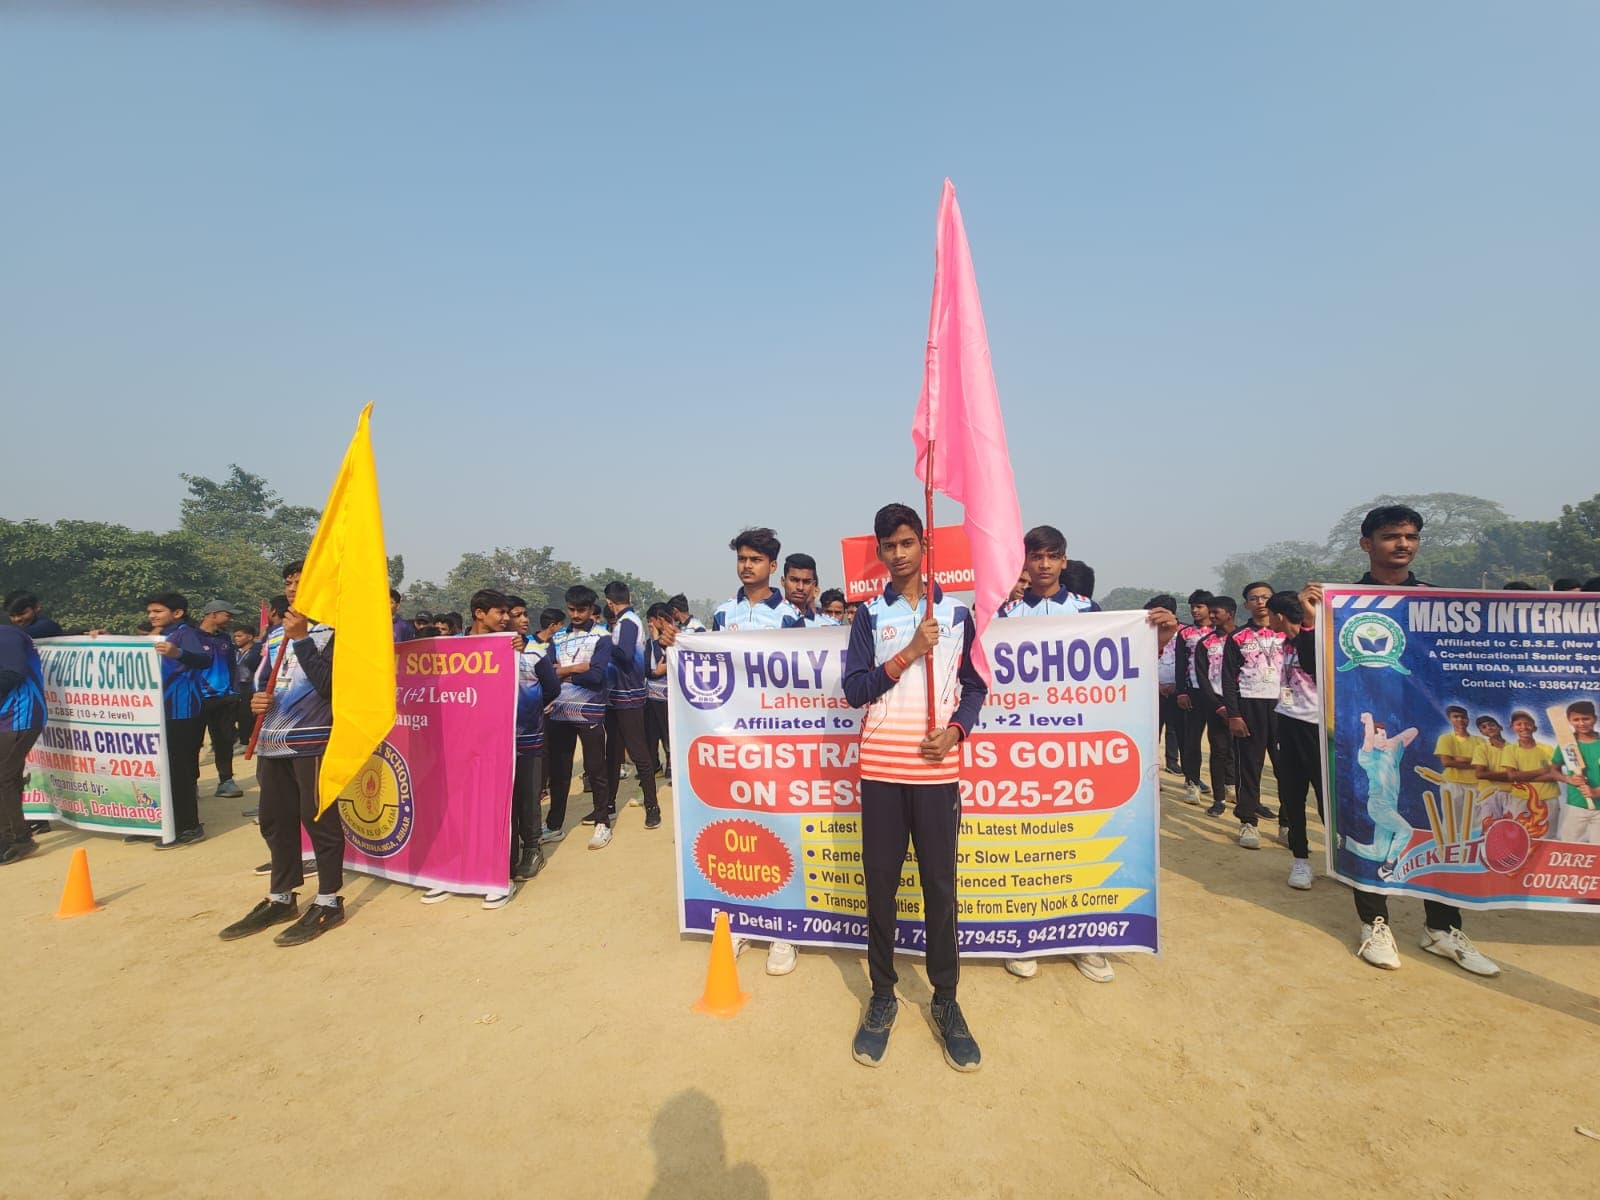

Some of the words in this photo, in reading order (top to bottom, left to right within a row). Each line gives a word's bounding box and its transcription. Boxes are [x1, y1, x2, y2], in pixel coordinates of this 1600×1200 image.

[850, 578, 878, 593] HOLY
[1408, 601, 1480, 634] MASS
[1435, 638, 1490, 648] Affiliated
[1494, 639, 1506, 648] to
[1509, 639, 1558, 649] C.B.S.E.
[1562, 640, 1594, 650] (New
[406, 650, 500, 676] SCHOOL
[744, 651, 828, 690] HOLY
[994, 637, 1140, 685] SCHOOL
[1428, 651, 1437, 659] A
[1440, 651, 1529, 660] Co-educational
[1532, 652, 1572, 661] Senior
[48, 650, 94, 689] PUBLIC
[98, 650, 159, 691] SCHOOL
[1442, 663, 1473, 672] EKMI
[1476, 664, 1513, 674] ROAD,
[1517, 665, 1588, 675] BALLOPUR,
[1462, 678, 1506, 689] Contact
[64, 692, 154, 709] DARBHANGA
[403, 687, 426, 705] (+2
[429, 687, 478, 708] Level)
[761, 692, 850, 710] Laherias
[1046, 685, 1128, 705] 846001
[107, 710, 135, 722] level)
[396, 713, 429, 731] anga
[734, 717, 826, 730] Affiliated
[832, 716, 854, 729] to
[995, 713, 1022, 727] +2
[1029, 712, 1084, 726] level
[42, 727, 92, 752] MISHRA
[27, 748, 96, 774] OURNAMENT
[108, 758, 157, 778] 2024
[697, 742, 860, 769] REGISTRA
[963, 741, 998, 768] IS
[1009, 738, 1129, 769] GOING
[50, 774, 88, 792] Organised
[384, 746, 410, 804] SCHOOL
[730, 780, 777, 806] ON
[960, 778, 1095, 808] 2025-26
[90, 800, 163, 823] Darbhanga
[820, 821, 858, 834] Latest
[957, 822, 973, 835] th
[977, 822, 1017, 836] Latest
[1021, 820, 1074, 836] Modules
[724, 829, 758, 853] Our
[822, 848, 861, 862] Reme
[955, 852, 970, 864] or
[975, 850, 1010, 864] Slow
[1015, 849, 1077, 864] Learners
[1548, 851, 1598, 869] DARE
[707, 854, 782, 884] Features
[821, 870, 850, 885] Well
[1011, 873, 1073, 888] Teachers
[1522, 872, 1600, 895] COURAGE
[824, 893, 867, 910] Transpo
[977, 899, 1003, 914] from
[1006, 899, 1037, 917] Every
[1040, 895, 1068, 912] Nook
[1070, 894, 1079, 908] &
[1081, 892, 1119, 908] Corner
[711, 907, 735, 924] Fr
[739, 911, 783, 932] Detail
[787, 919, 798, 932] :-
[1027, 920, 1130, 944] 9421270967
